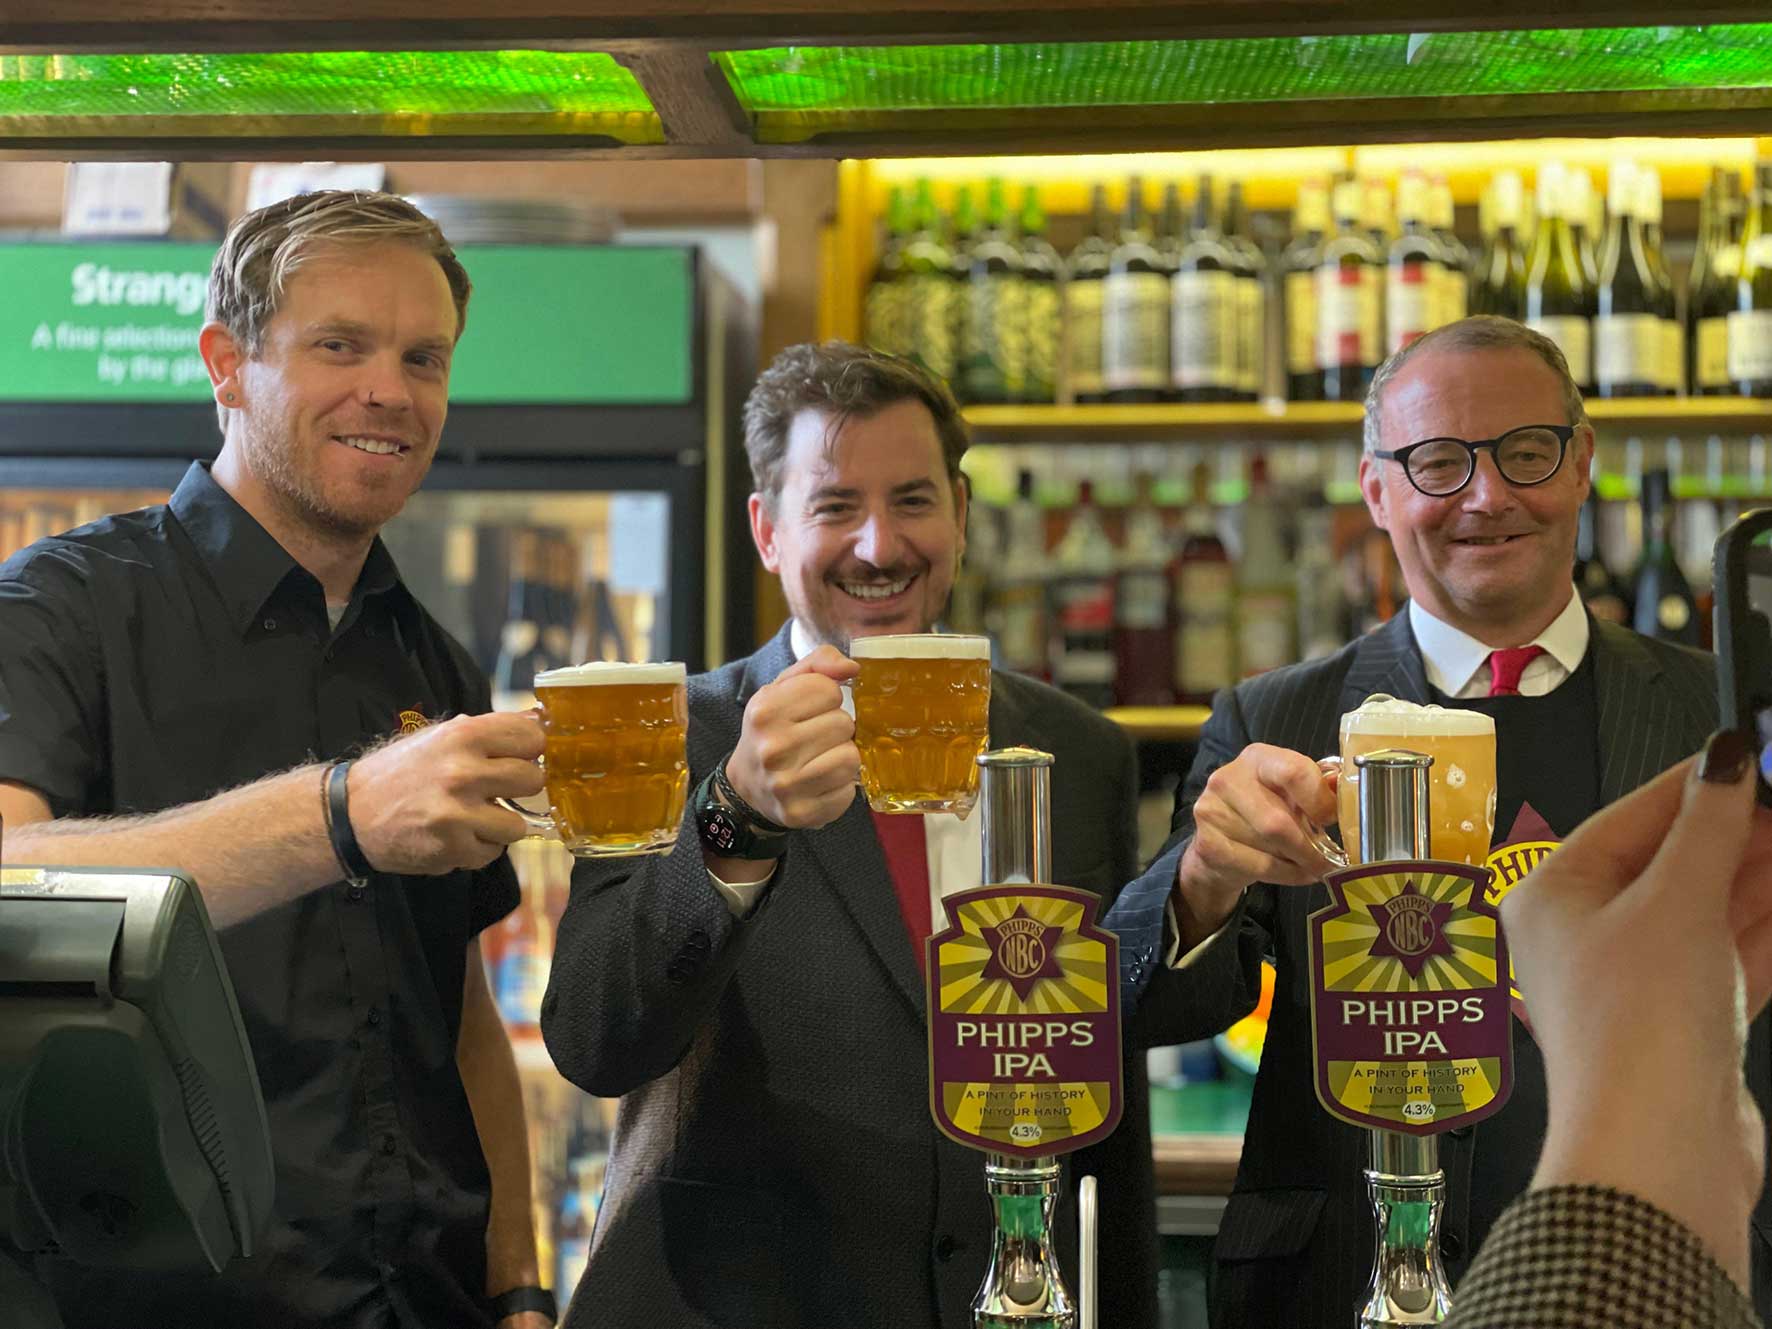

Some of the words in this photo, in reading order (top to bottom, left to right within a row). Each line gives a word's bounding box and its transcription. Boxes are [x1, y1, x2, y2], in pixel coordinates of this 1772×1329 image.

[71, 263, 209, 315] Strang
[32, 323, 53, 351] A
[55, 321, 100, 352] fine
[97, 354, 128, 385] by
[129, 354, 168, 382] the
[1388, 899, 1434, 914] PHIPPS
[1000, 920, 1044, 936] PHIPPS
[1393, 910, 1429, 951] NBC
[1005, 934, 1039, 973] NBC
[1342, 997, 1486, 1026] PHIPPS
[956, 1021, 1095, 1048] PHIPPS
[1383, 1031, 1448, 1056] IPA
[993, 1053, 1058, 1078] IPA
[1353, 1069, 1363, 1078] A
[1367, 1069, 1397, 1078] PINT
[1401, 1069, 1419, 1079] OF
[1423, 1066, 1478, 1078] HISTORY
[965, 1091, 974, 1100] A
[977, 1091, 1007, 1100] PINT
[1009, 1091, 1026, 1100] OF
[1030, 1089, 1086, 1100] HISTORY
[1369, 1085, 1383, 1095] IN
[1387, 1085, 1423, 1095] YOUR
[1427, 1084, 1465, 1095] HAND
[979, 1108, 993, 1117] IN
[997, 1107, 1031, 1117] YOUR
[1034, 1106, 1072, 1117] HAND
[1404, 1104, 1434, 1116] 4.3%
[1011, 1126, 1041, 1138] 4.3%
